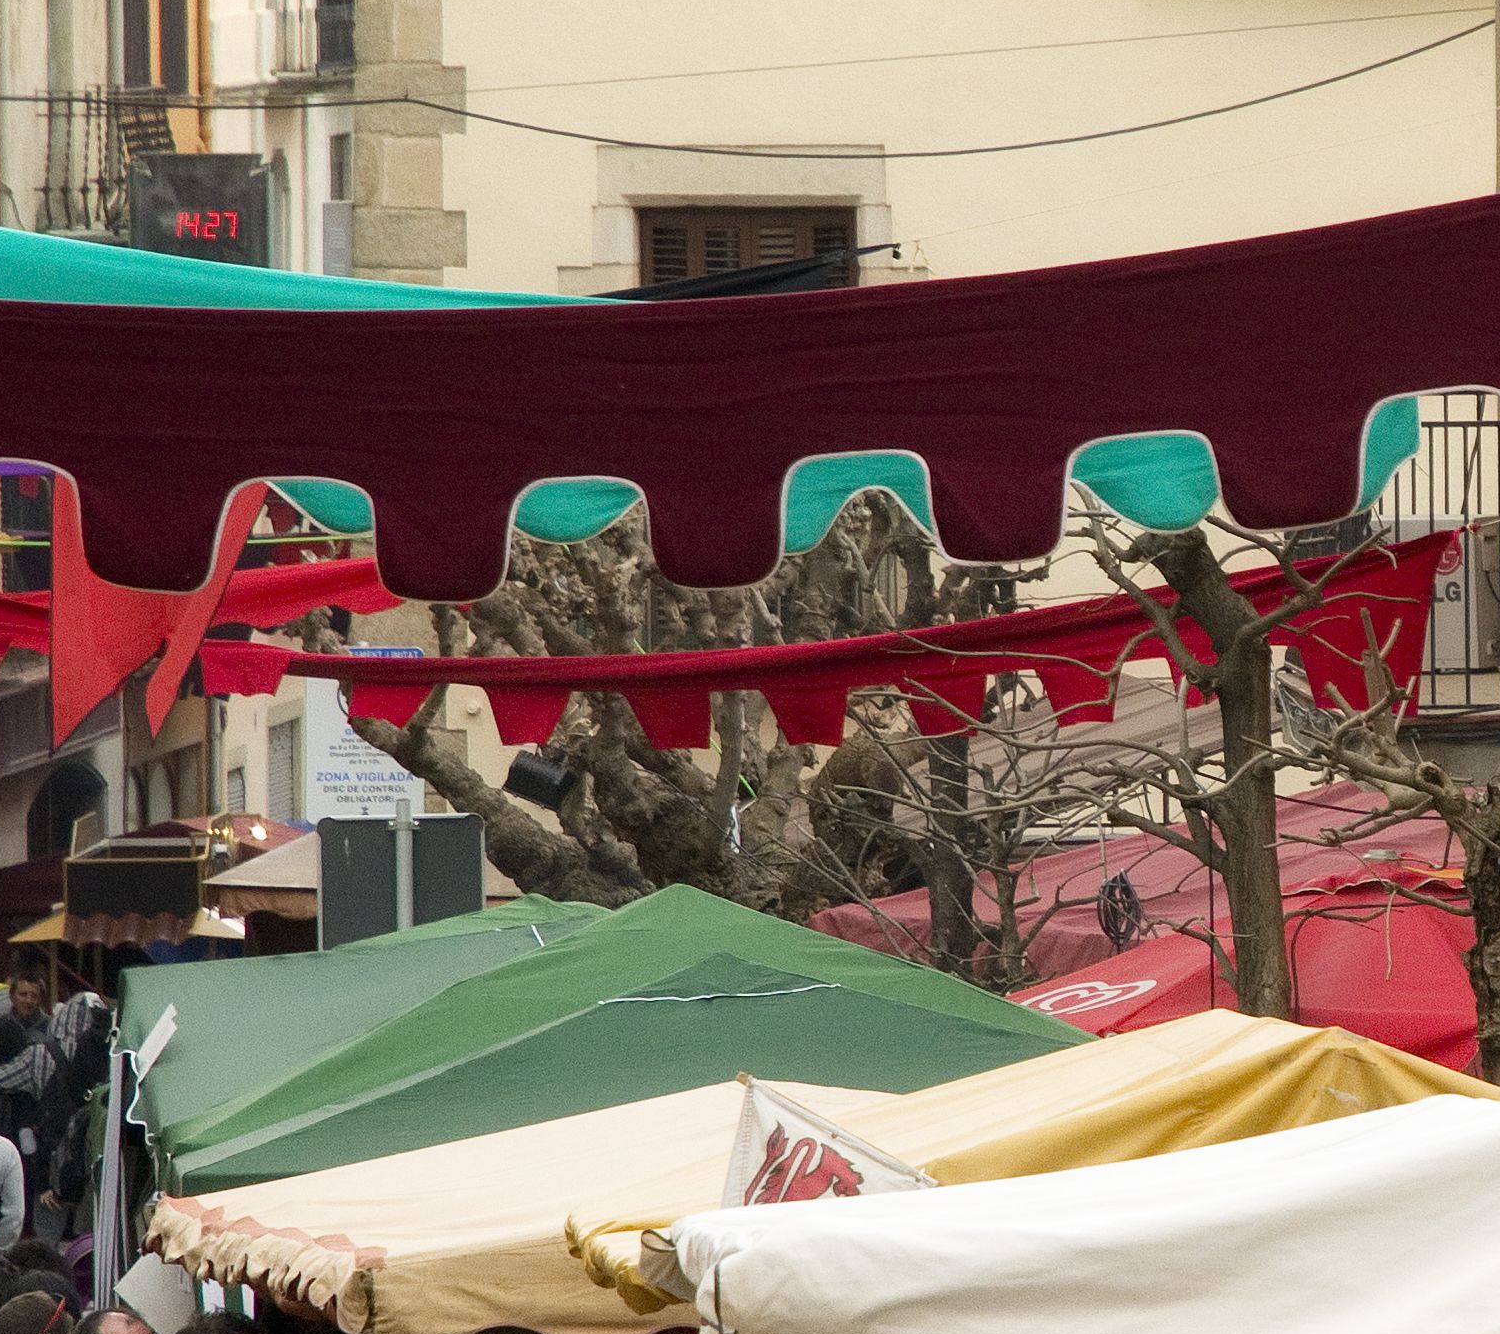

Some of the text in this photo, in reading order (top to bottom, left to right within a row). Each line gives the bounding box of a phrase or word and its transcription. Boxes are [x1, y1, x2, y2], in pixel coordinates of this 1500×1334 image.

[1431, 581, 1462, 603] LG
[316, 771, 414, 782] ZONA VIGILADA
[323, 785, 407, 793] DISC DE CONTROL
